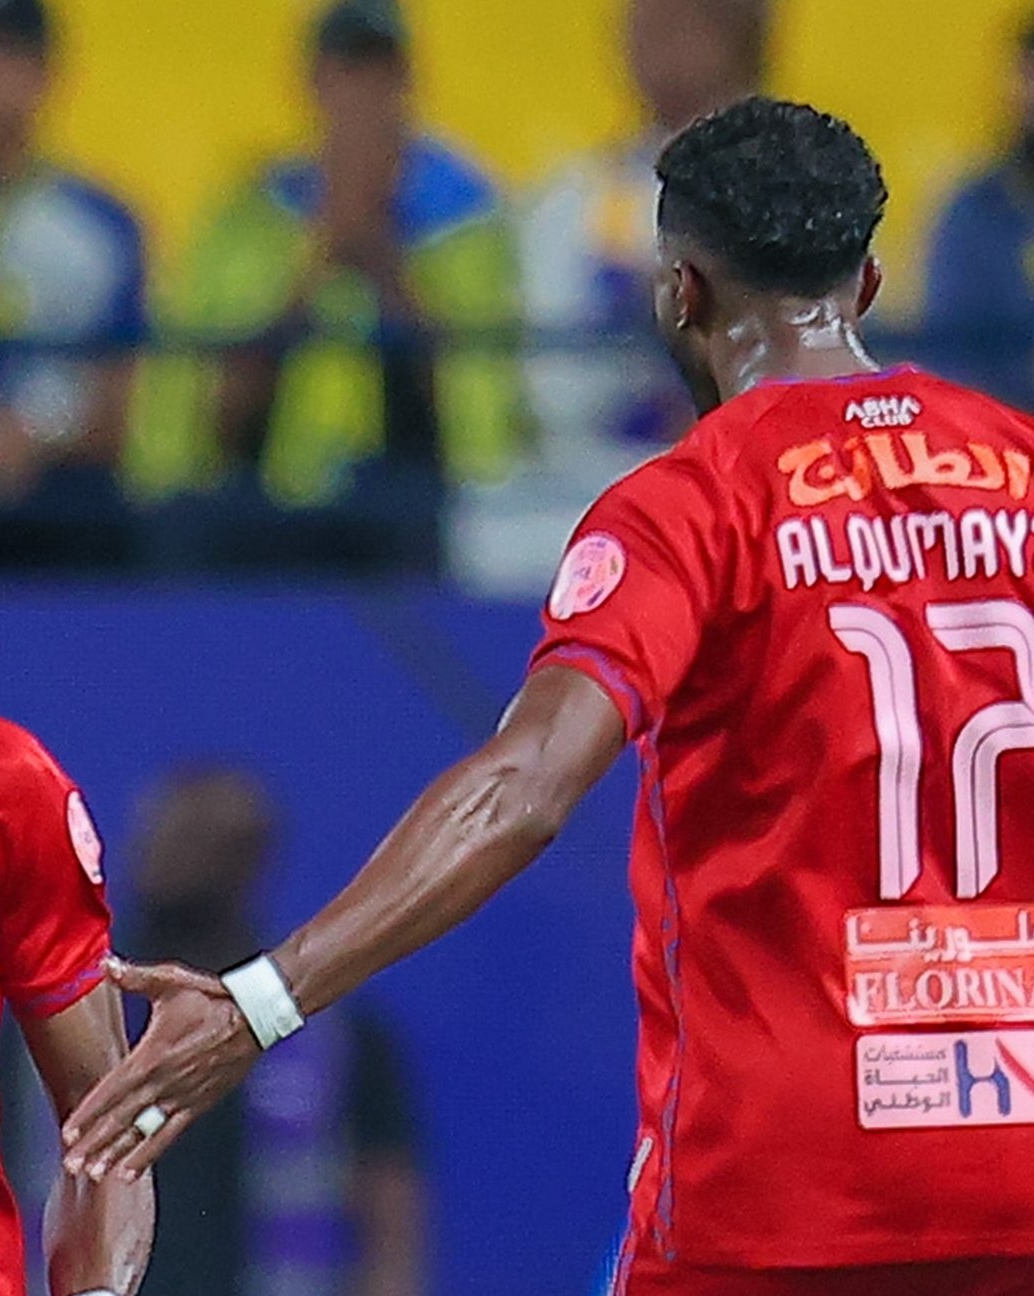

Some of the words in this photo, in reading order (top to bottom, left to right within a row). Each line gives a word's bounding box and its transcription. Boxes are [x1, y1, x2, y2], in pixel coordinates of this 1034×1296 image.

[846, 396, 920, 421] ABHA
[777, 508, 1034, 592] ALQUMAY
[829, 600, 1034, 900] 12
[846, 909, 1034, 963] لورينا
[855, 967, 1034, 1012] FLORIN
